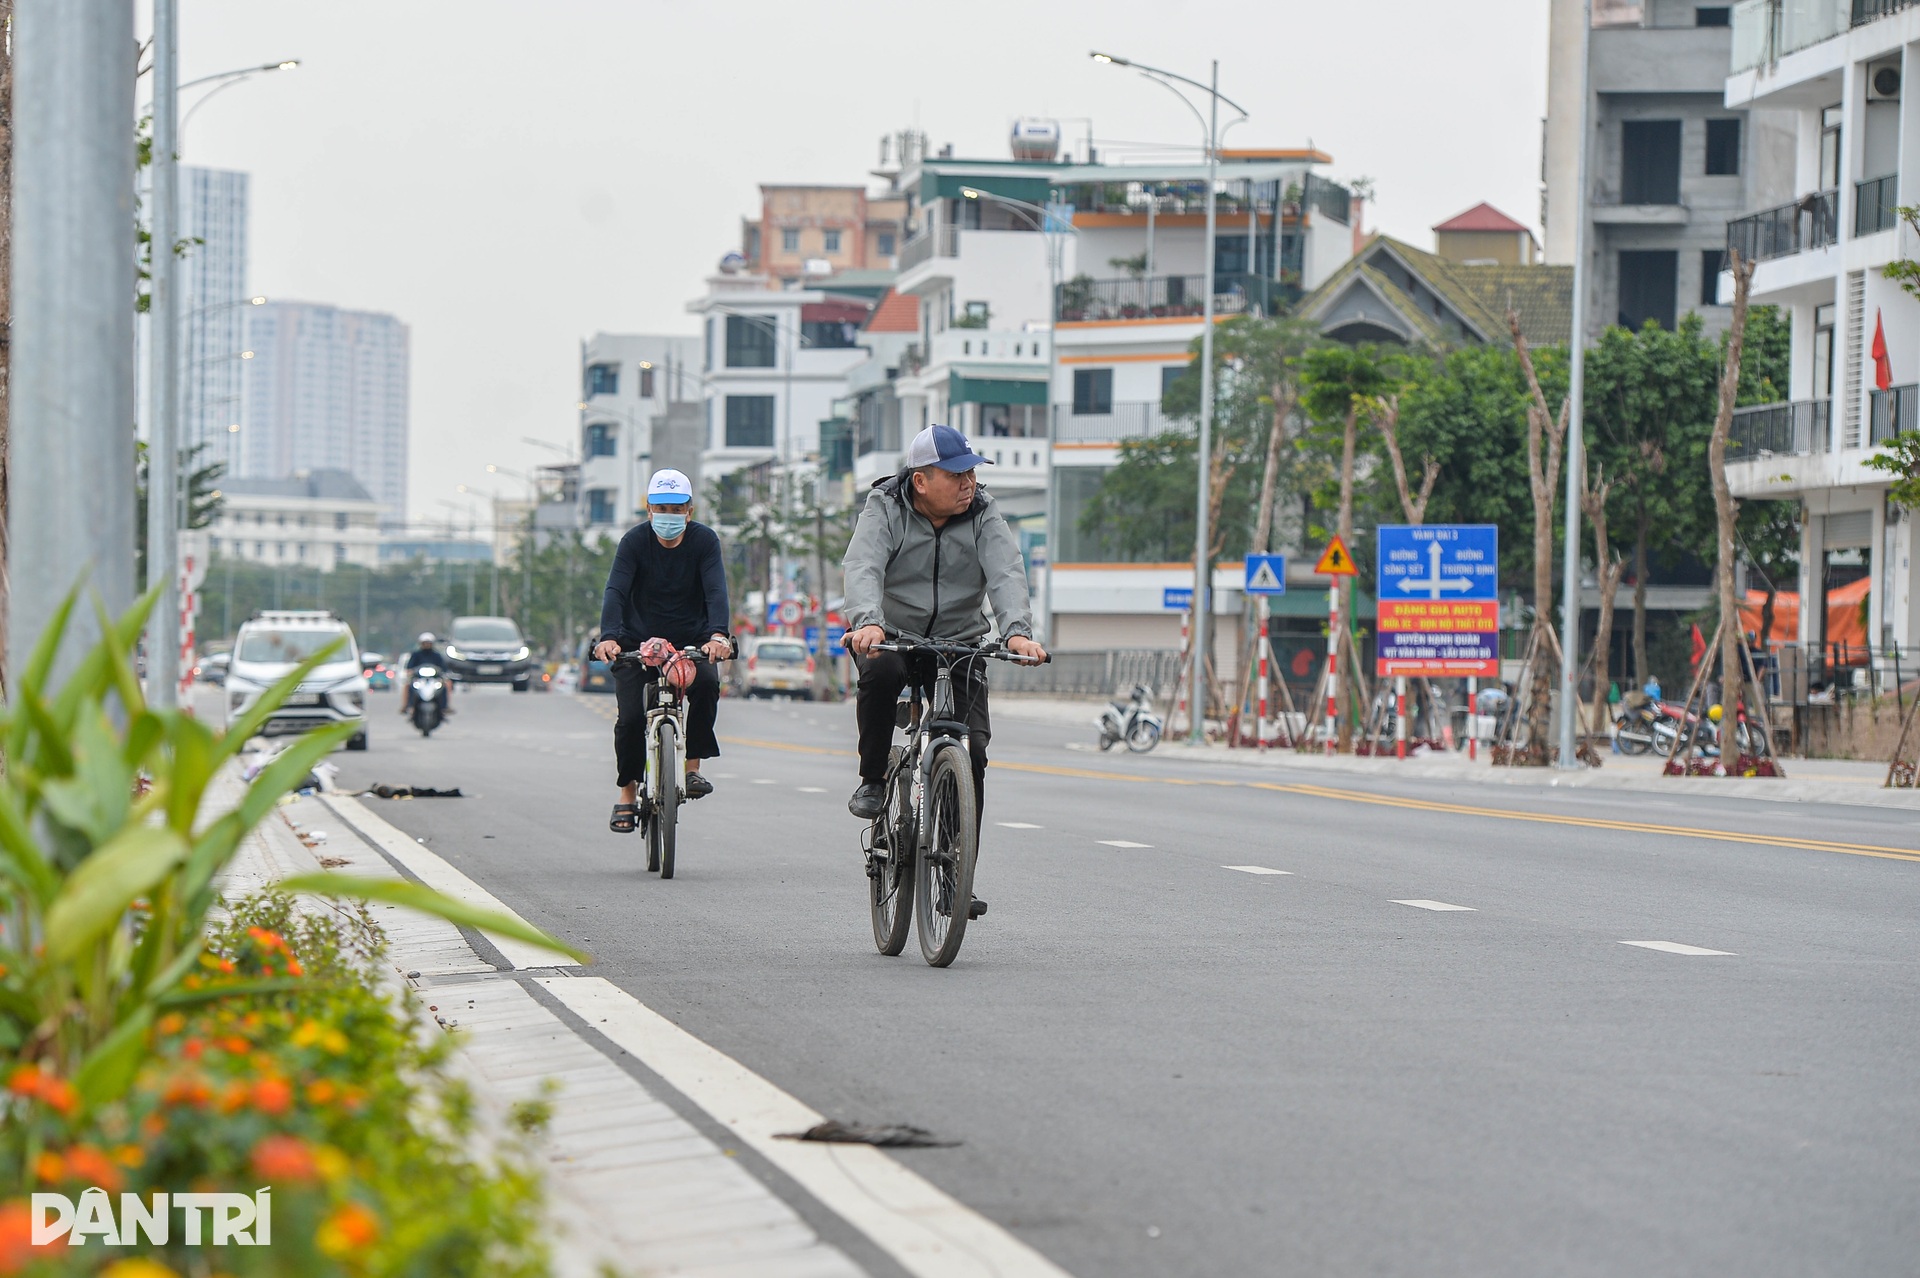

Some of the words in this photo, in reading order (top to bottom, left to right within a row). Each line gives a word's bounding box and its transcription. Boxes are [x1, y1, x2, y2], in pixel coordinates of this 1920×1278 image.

[1412, 529, 1434, 540] VÀNH
[1451, 530, 1459, 541] 3
[1453, 605, 1482, 616] AUTO
